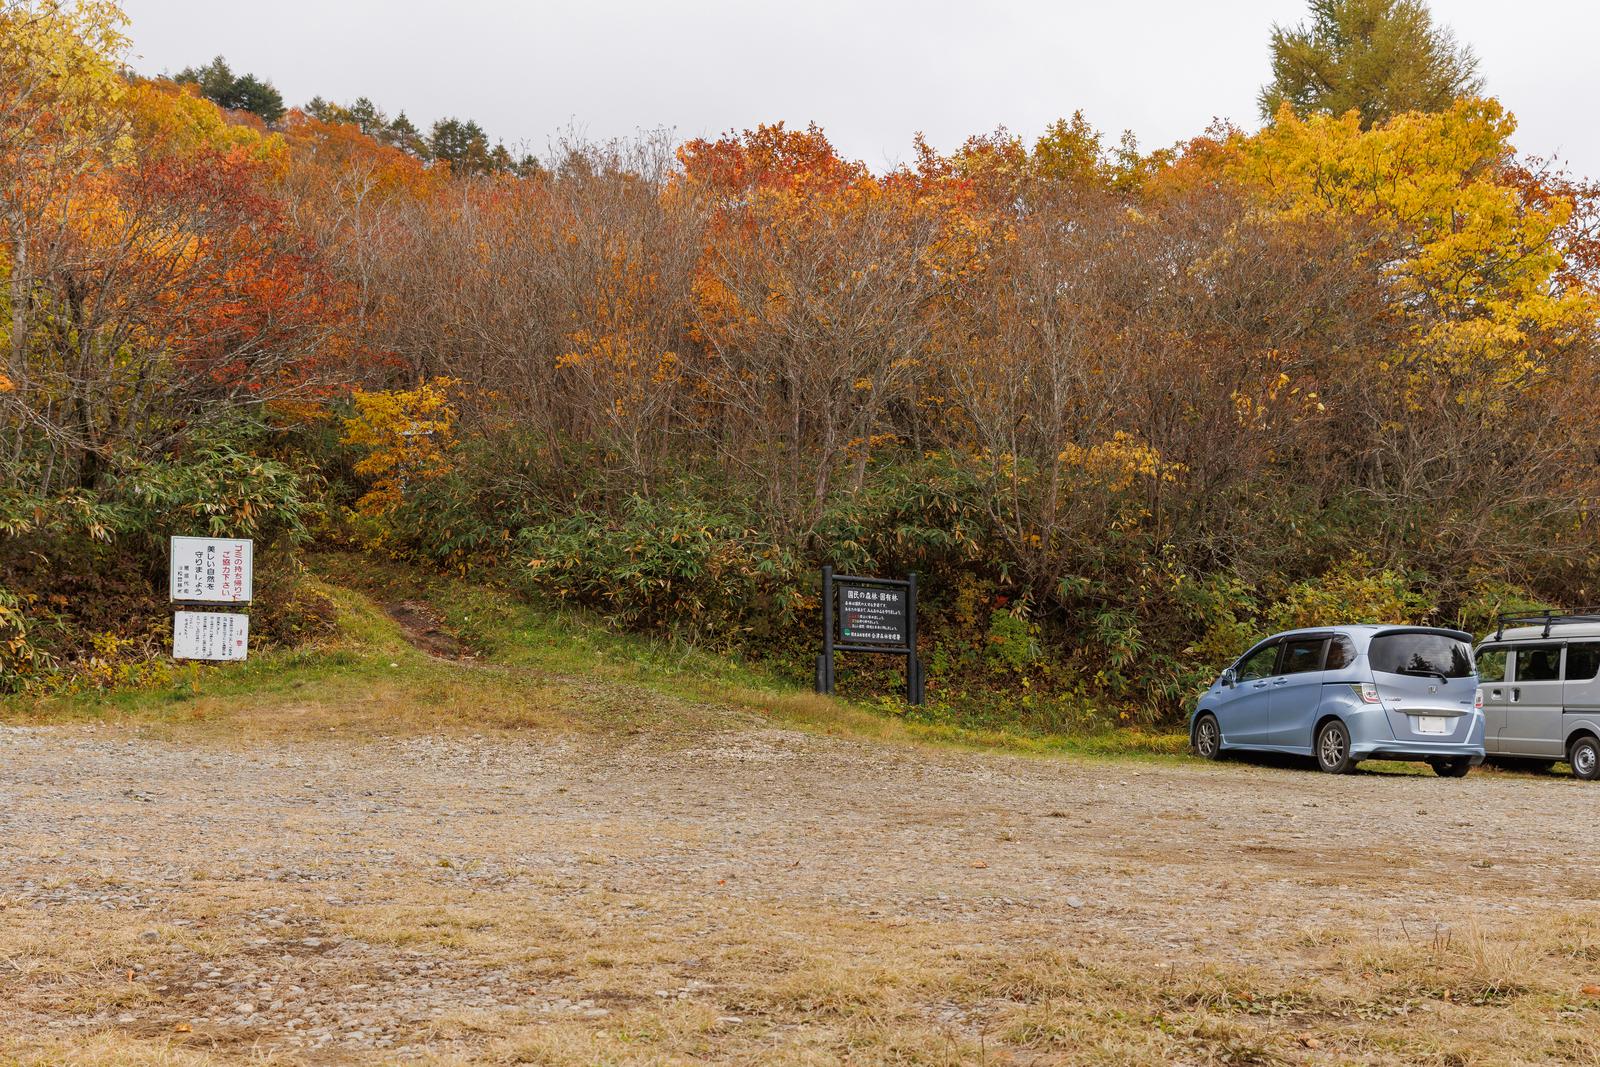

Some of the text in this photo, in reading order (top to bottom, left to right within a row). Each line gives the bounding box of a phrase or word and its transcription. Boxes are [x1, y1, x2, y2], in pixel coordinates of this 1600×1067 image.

[195, 551, 203, 596] 守りましょう
[206, 545, 216, 591] 美しい自然を
[222, 551, 230, 596] ご協力下さい
[233, 544, 243, 600] ゴミの持ち帰りに
